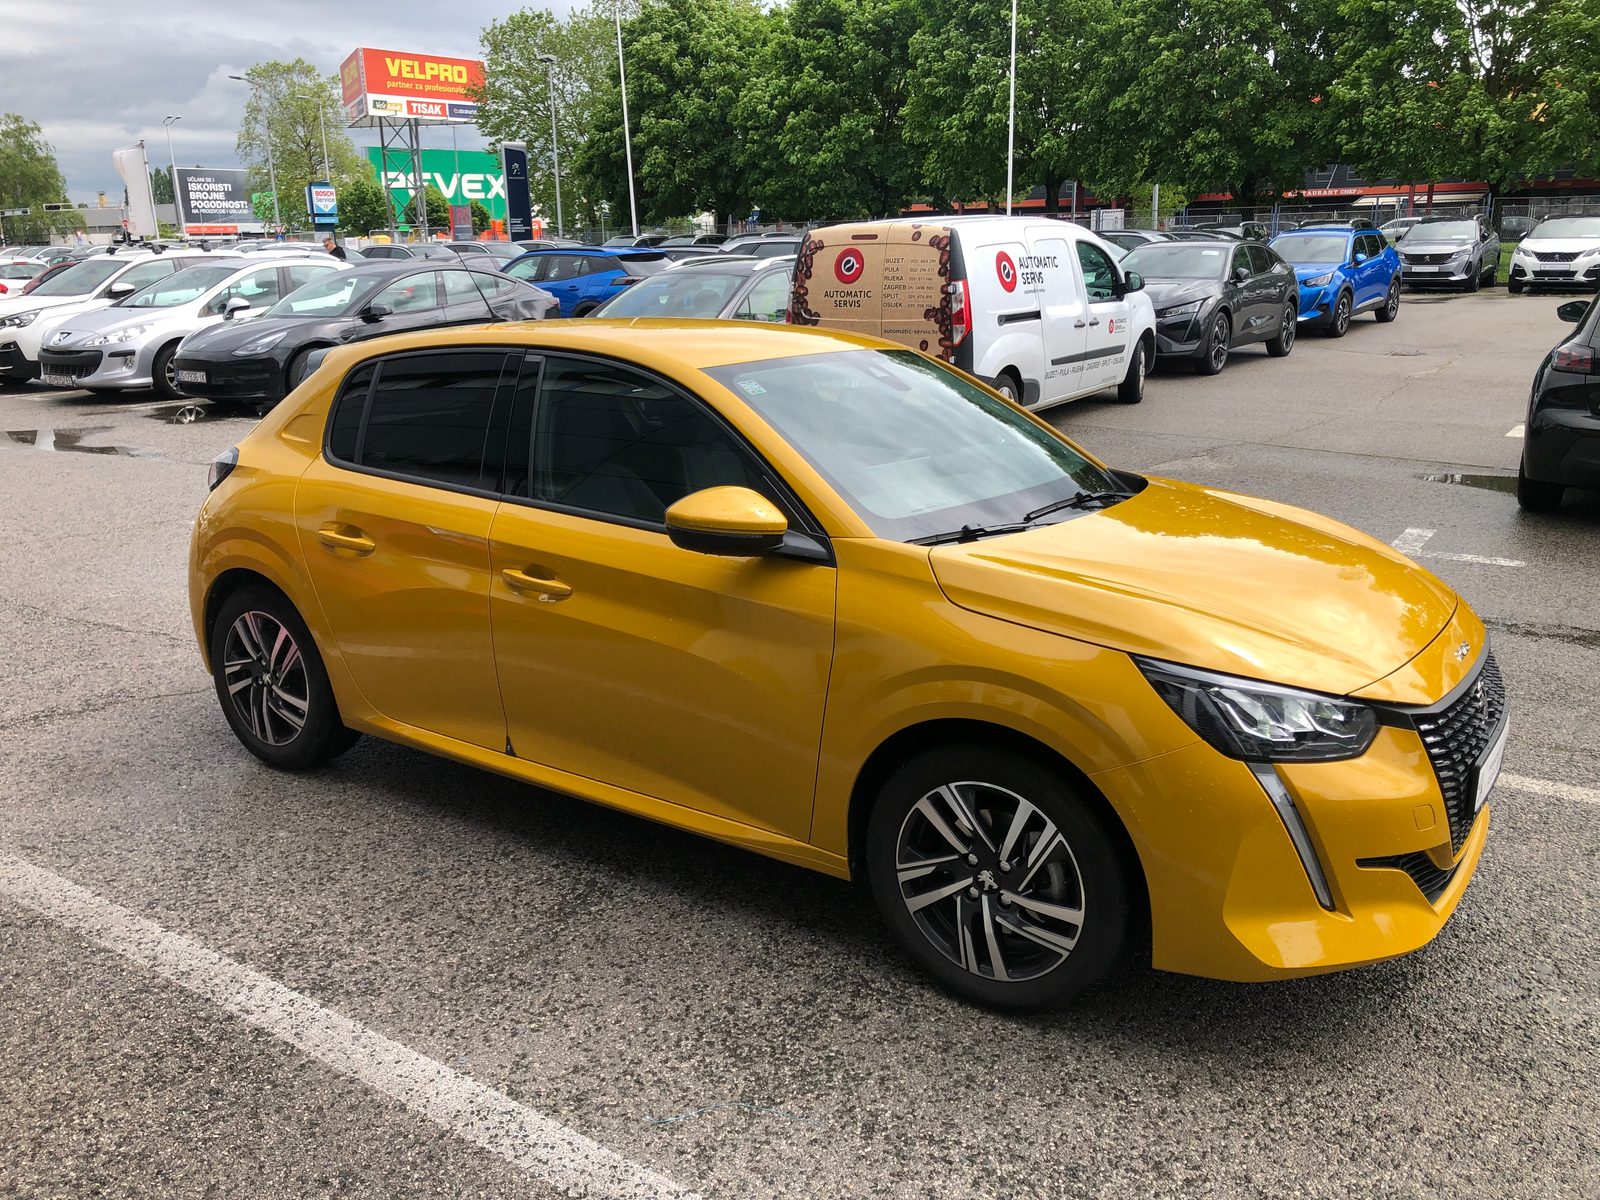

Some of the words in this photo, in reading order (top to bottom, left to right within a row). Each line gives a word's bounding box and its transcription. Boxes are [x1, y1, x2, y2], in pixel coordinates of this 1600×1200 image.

[385, 57, 468, 84] VELPRO
[386, 80, 413, 90] partner
[424, 83, 467, 94] profesionalc
[411, 102, 442, 115] TISAK
[187, 182, 232, 192] ISKORISTI
[380, 171, 506, 199] PEVEX
[189, 191, 226, 200] BROJNE
[1018, 255, 1058, 270] AUTOMATIC
[1021, 271, 1044, 285] SERVS
[823, 290, 872, 299] AUTOMATIC
[833, 299, 861, 308] SERVIS
[883, 327, 938, 335] automatic-servis.hr
